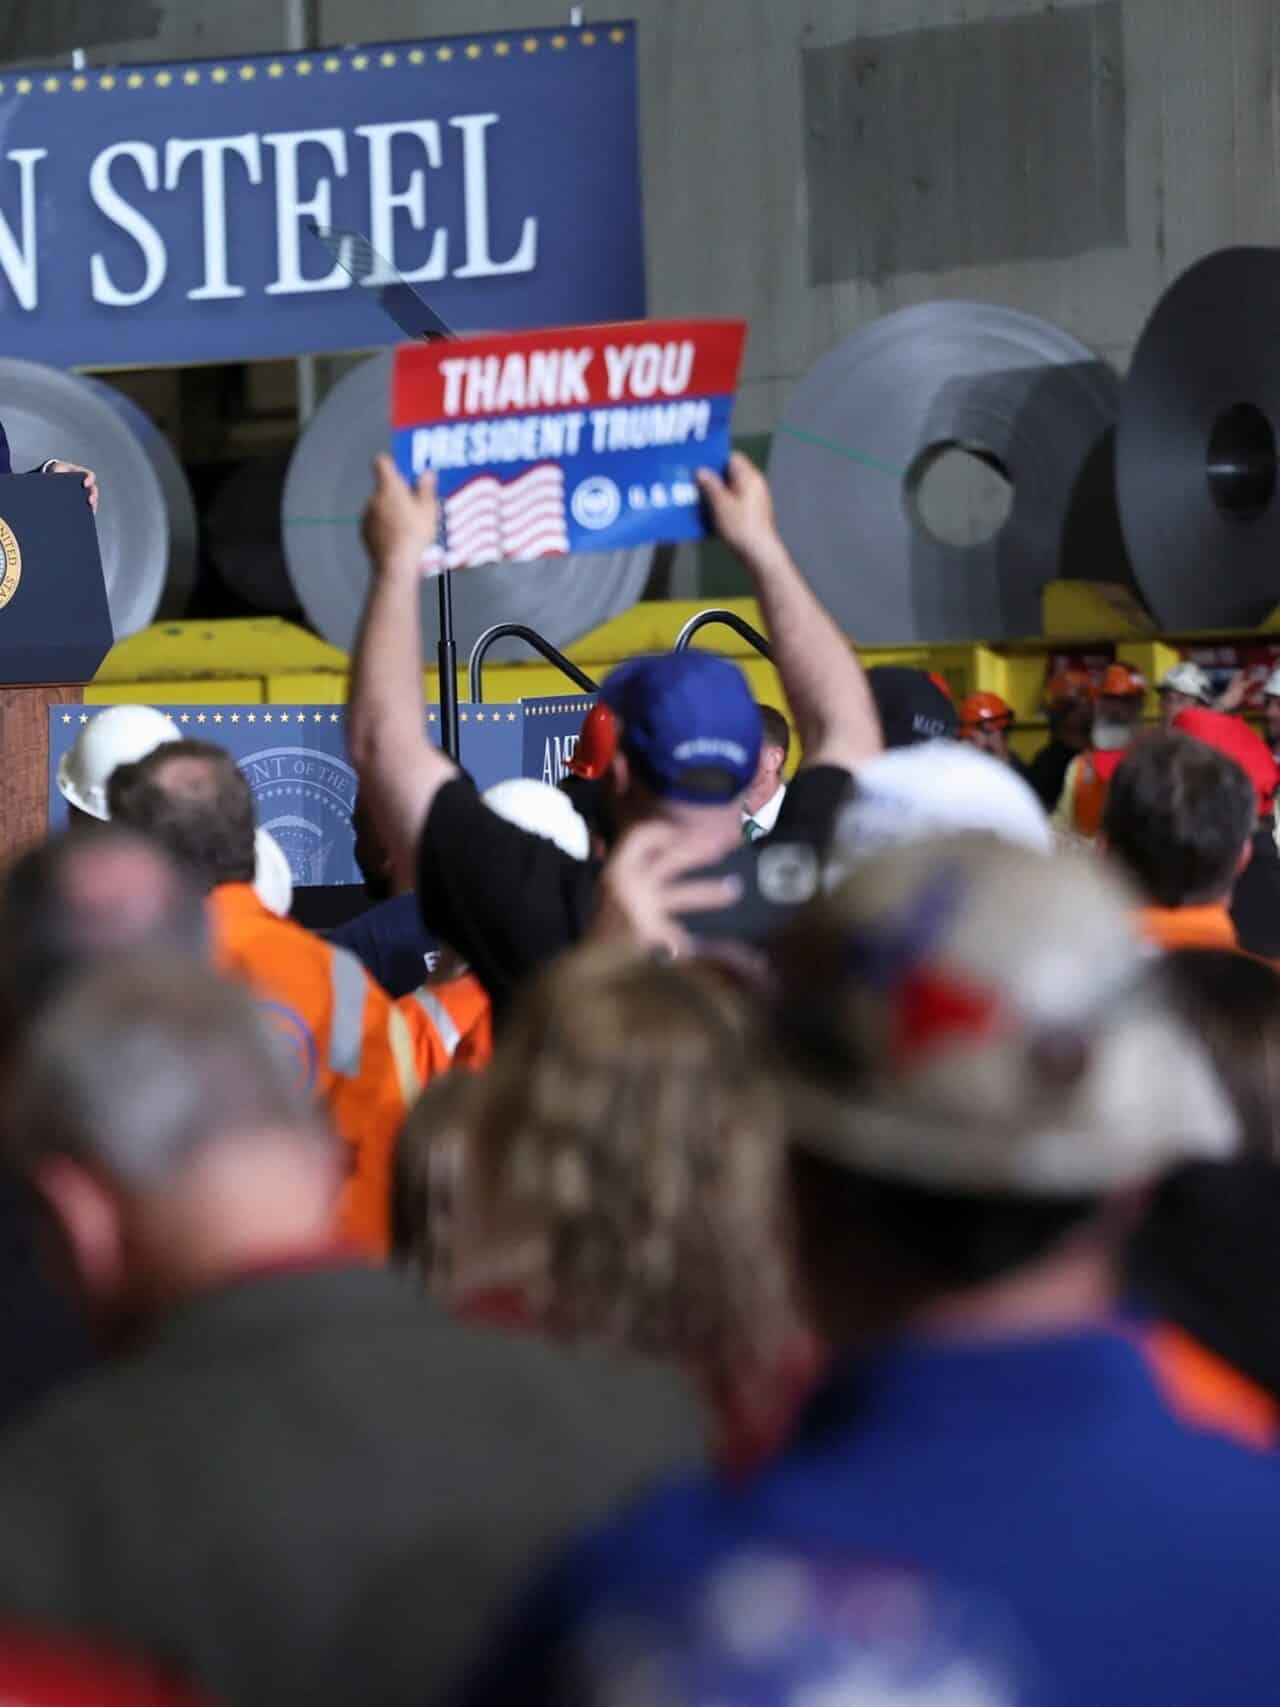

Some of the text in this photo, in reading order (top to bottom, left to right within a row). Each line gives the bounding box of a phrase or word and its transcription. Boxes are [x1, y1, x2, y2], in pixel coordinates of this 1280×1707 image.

[90, 113, 538, 306] STEEL
[438, 340, 695, 417] THANK YOU
[411, 398, 711, 475] PRESIDENT TRUMP!
[293, 760, 315, 776] OF
[320, 766, 350, 792] THE
